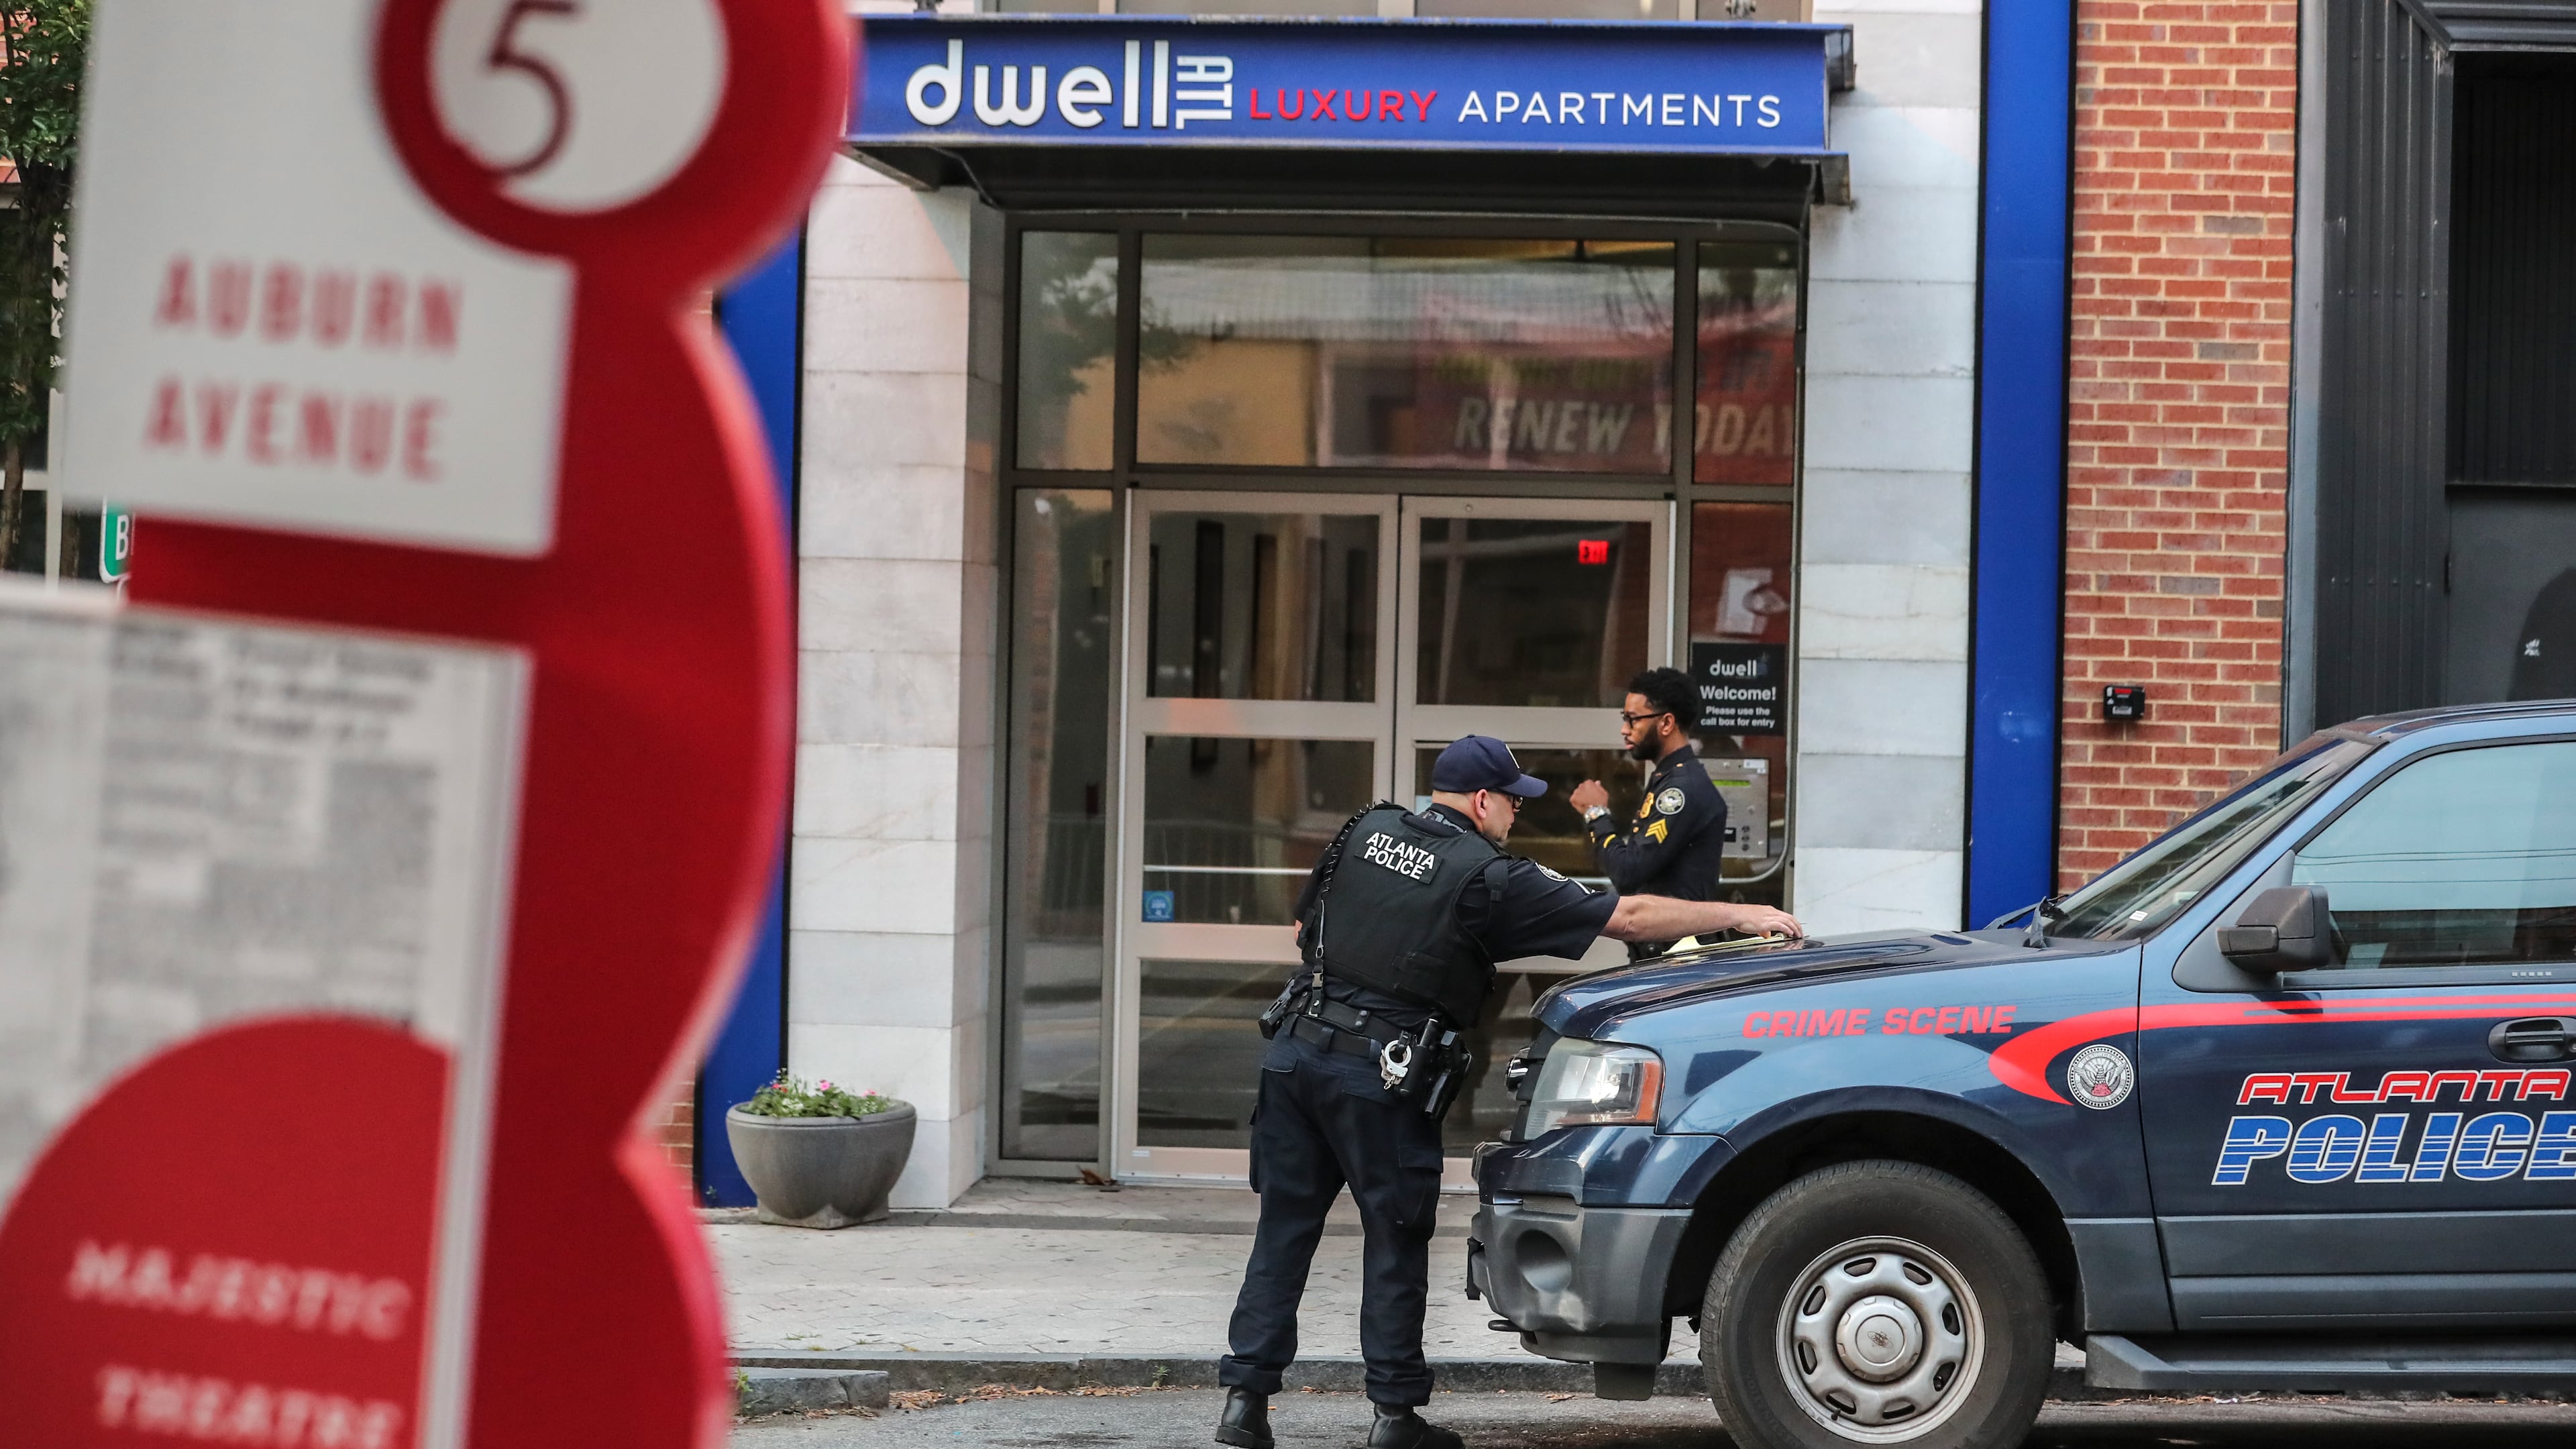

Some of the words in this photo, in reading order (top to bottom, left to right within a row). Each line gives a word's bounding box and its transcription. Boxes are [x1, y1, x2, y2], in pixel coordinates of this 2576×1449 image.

[484, 0, 580, 178] 5
[905, 39, 1169, 127] dwell
[1175, 56, 1233, 129] ATL
[1250, 89, 1438, 122] LUXURY
[1458, 91, 1782, 127] APARTMENTS
[154, 254, 464, 359] AUBURN
[143, 377, 447, 478] AVENUE
[1454, 397, 1634, 453] RENEW
[1709, 659, 1757, 676] dwell
[1699, 685, 1776, 700] Welcome!
[1705, 706, 1735, 715] Please
[1737, 708, 1754, 716] use
[1756, 706, 1770, 716] the
[1701, 717, 1717, 726] call
[1719, 717, 1735, 726] box
[1737, 717, 1750, 727] for
[1752, 718, 1775, 729] entry
[1363, 845, 1426, 880] POLICE
[1365, 832, 1435, 870] ATLANTA
[1742, 1008, 1870, 1038] CRIME
[1881, 1006, 2017, 1035] SCENE
[2236, 1069, 2572, 1105] ATLANTA
[2211, 1111, 2576, 1185] POLICE
[67, 1240, 411, 1340] MAJESTIC
[97, 1365, 404, 1449] THEATRE
